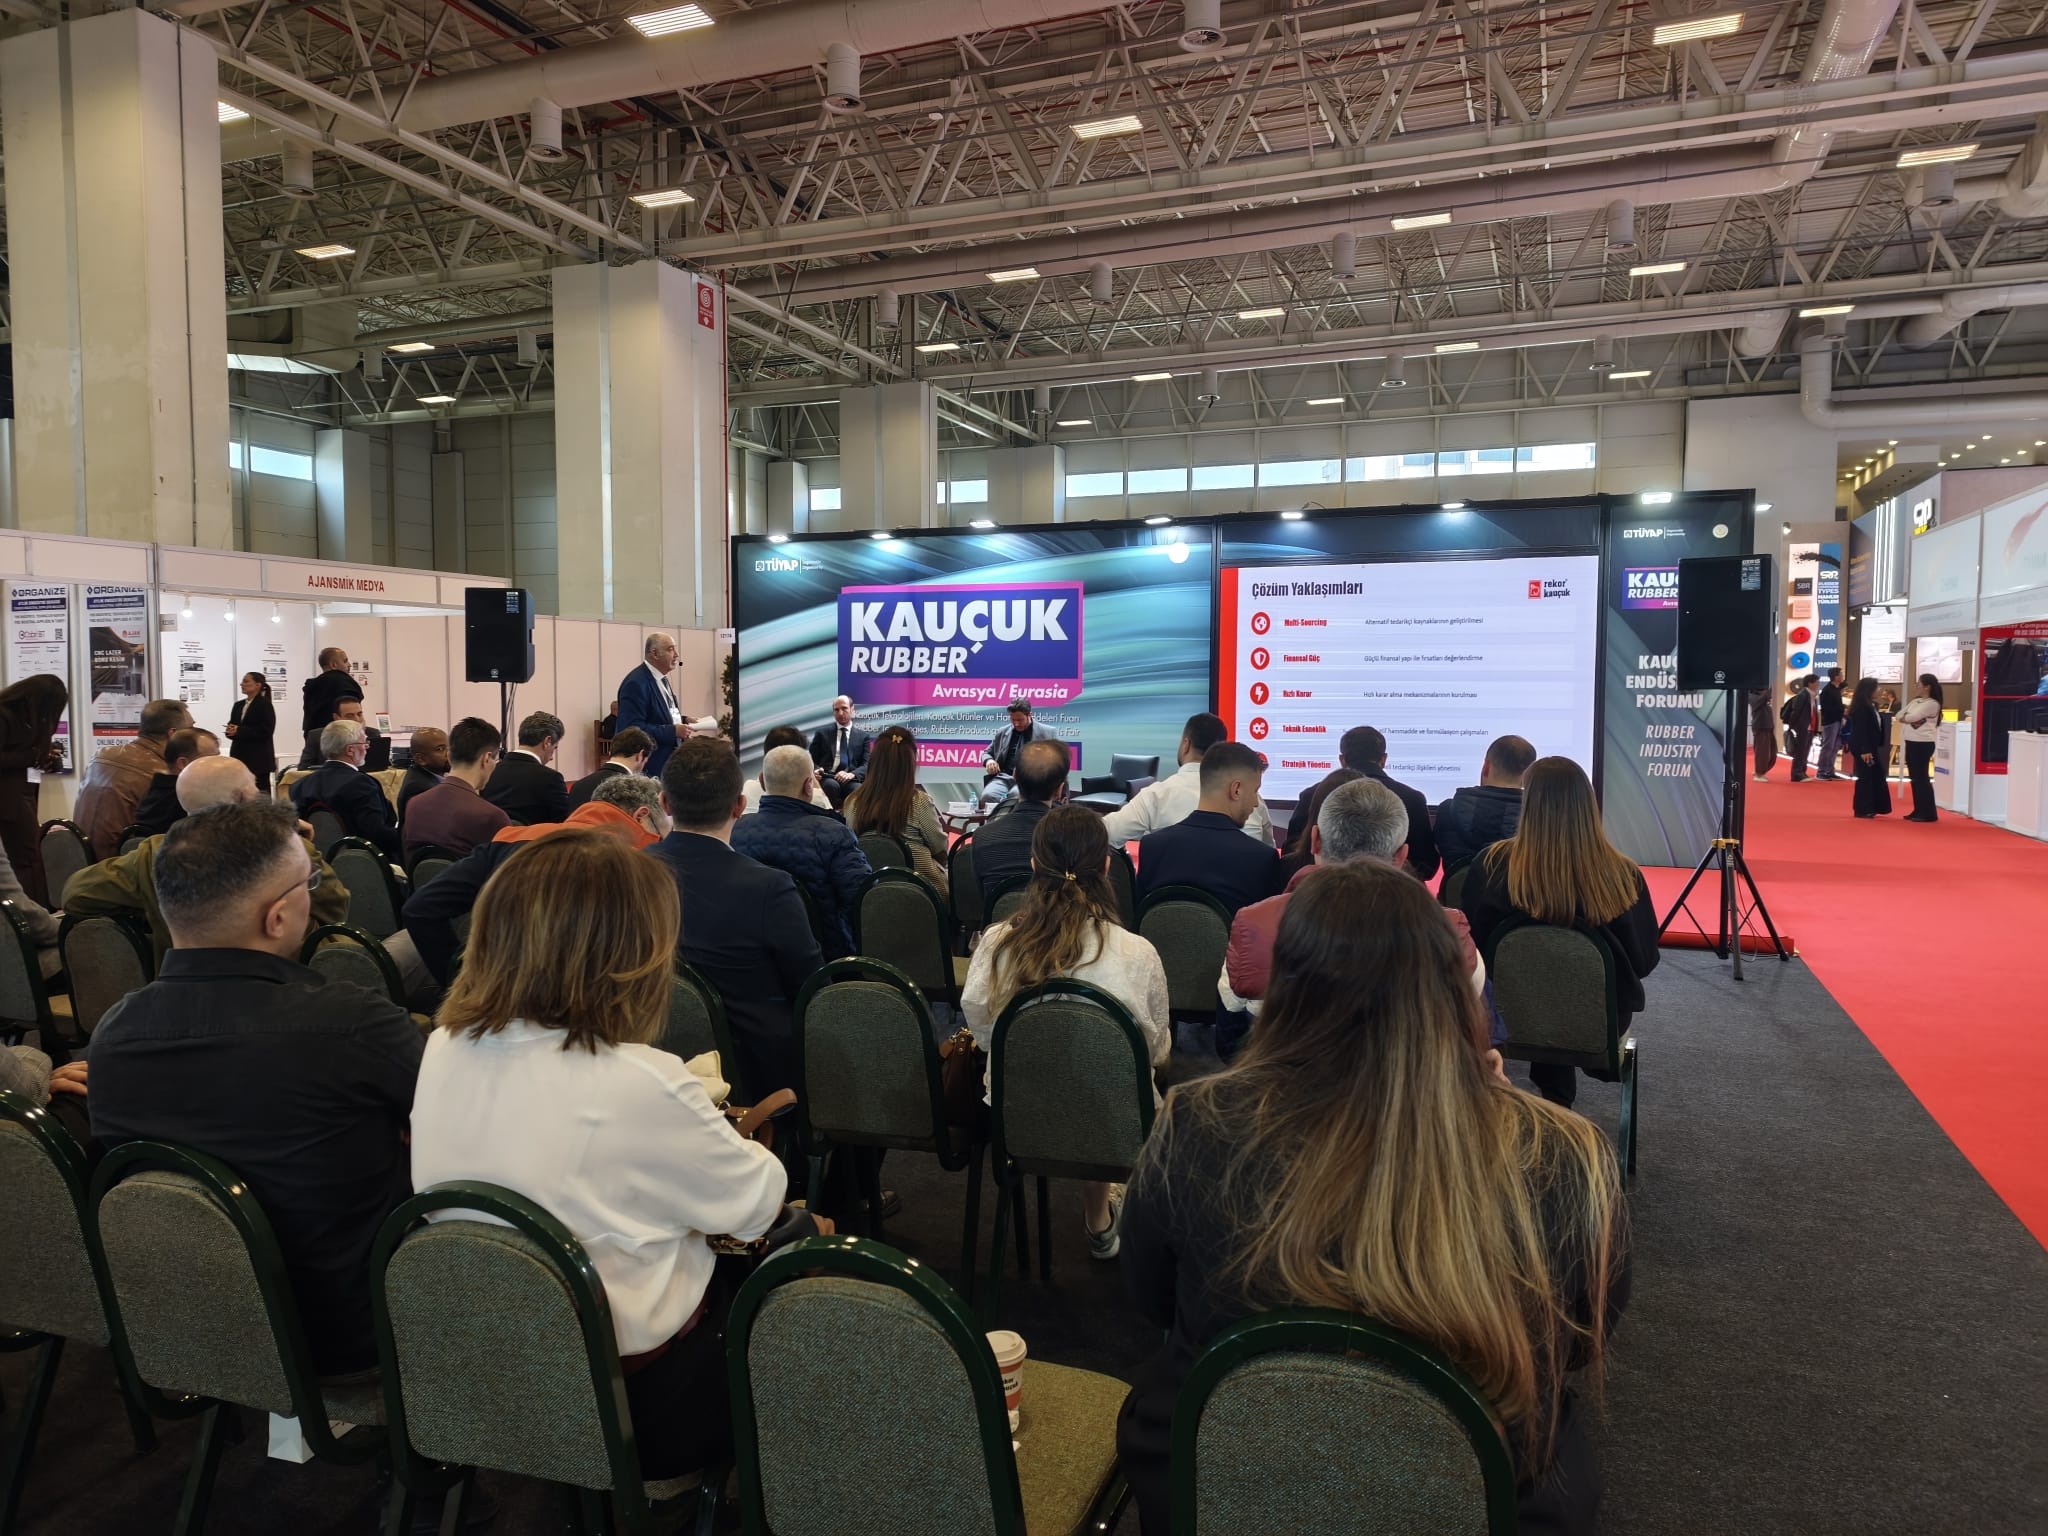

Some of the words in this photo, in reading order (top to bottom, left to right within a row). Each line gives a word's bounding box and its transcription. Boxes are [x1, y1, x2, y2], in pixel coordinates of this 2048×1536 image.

[1632, 527, 1663, 538] TÜYAP
[765, 557, 799, 571] TÜYAP
[307, 575, 355, 590] AJANSMİK
[356, 580, 385, 592] MEDYA
[1252, 582, 1289, 599] Çözüm
[1291, 581, 1364, 598] Yaklaşımları
[1544, 579, 1566, 588] rekor
[1543, 588, 1571, 599] kauçuk
[1627, 588, 1678, 599] RUBBER
[850, 599, 1069, 655] KAUÇUK
[1821, 618, 1835, 626] NR
[850, 646, 969, 674] RUBBER
[1625, 671, 1678, 690] ENDÜS
[932, 684, 997, 702] Avrasya
[1009, 683, 1068, 700] Eurasia
[1636, 694, 1704, 709] FORUMU
[927, 711, 954, 722] Kauçuk
[956, 711, 983, 721] Ürünler
[985, 713, 995, 721] ve
[996, 712, 1011, 721] Ha
[930, 724, 958, 734] Rubber
[959, 725, 990, 736] Products
[1065, 727, 1081, 737] Fair
[1645, 724, 1696, 740] RUBBER
[1639, 743, 1702, 759] INDUSTRY
[1647, 762, 1692, 778] FORUM
